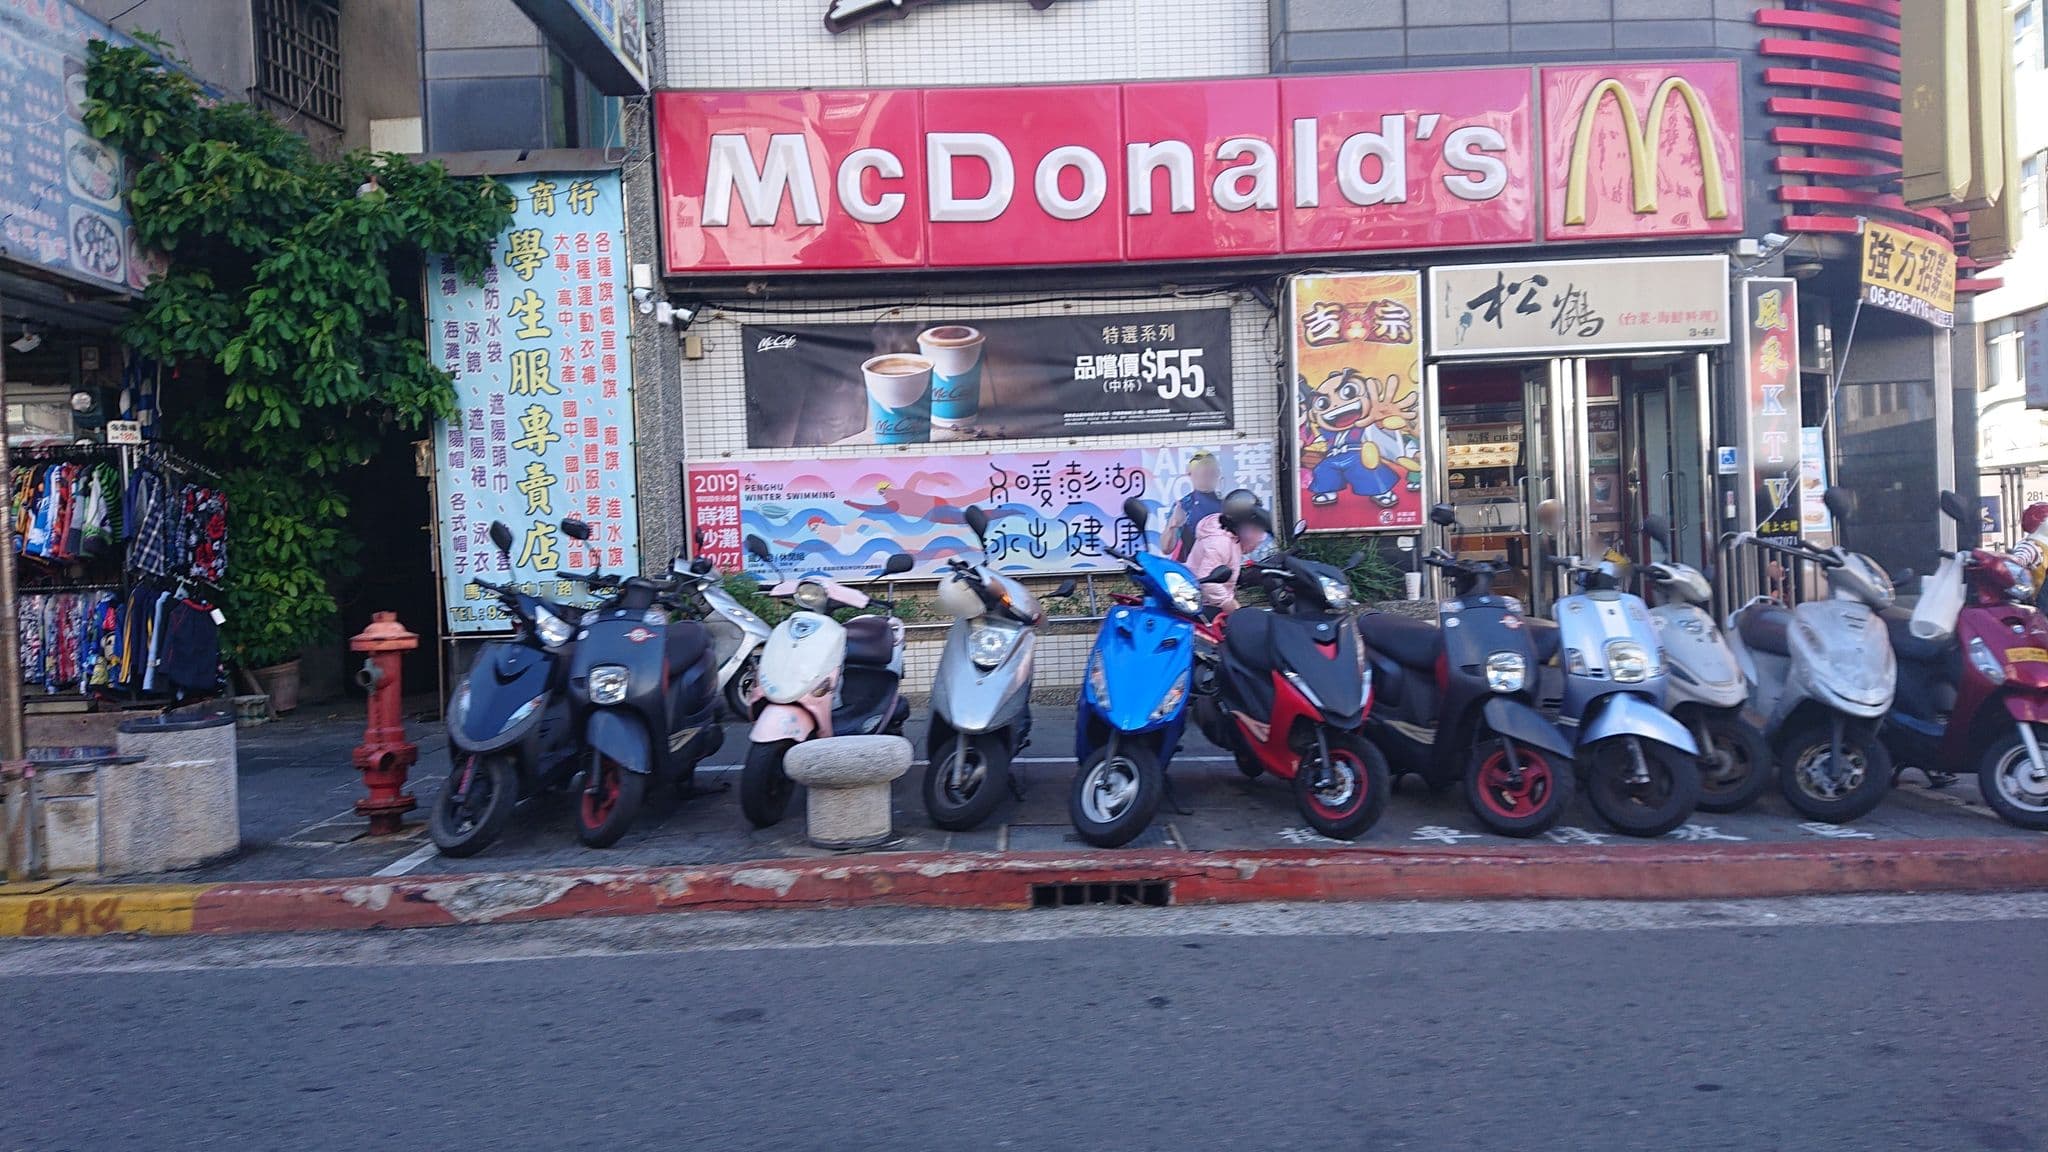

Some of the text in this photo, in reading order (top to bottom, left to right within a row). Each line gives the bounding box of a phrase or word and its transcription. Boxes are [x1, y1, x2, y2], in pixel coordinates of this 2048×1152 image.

[701, 112, 1508, 227] McDonald's
[1102, 324, 1175, 344] 特選系列
[1141, 347, 1205, 400] $55
[1102, 379, 1142, 393] (中杯)
[504, 227, 561, 572] 學生服專賣店
[694, 473, 738, 493] 2019
[744, 484, 784, 492] PENGHU
[744, 493, 782, 502] WINTER
[786, 491, 836, 500] SWIMMING
